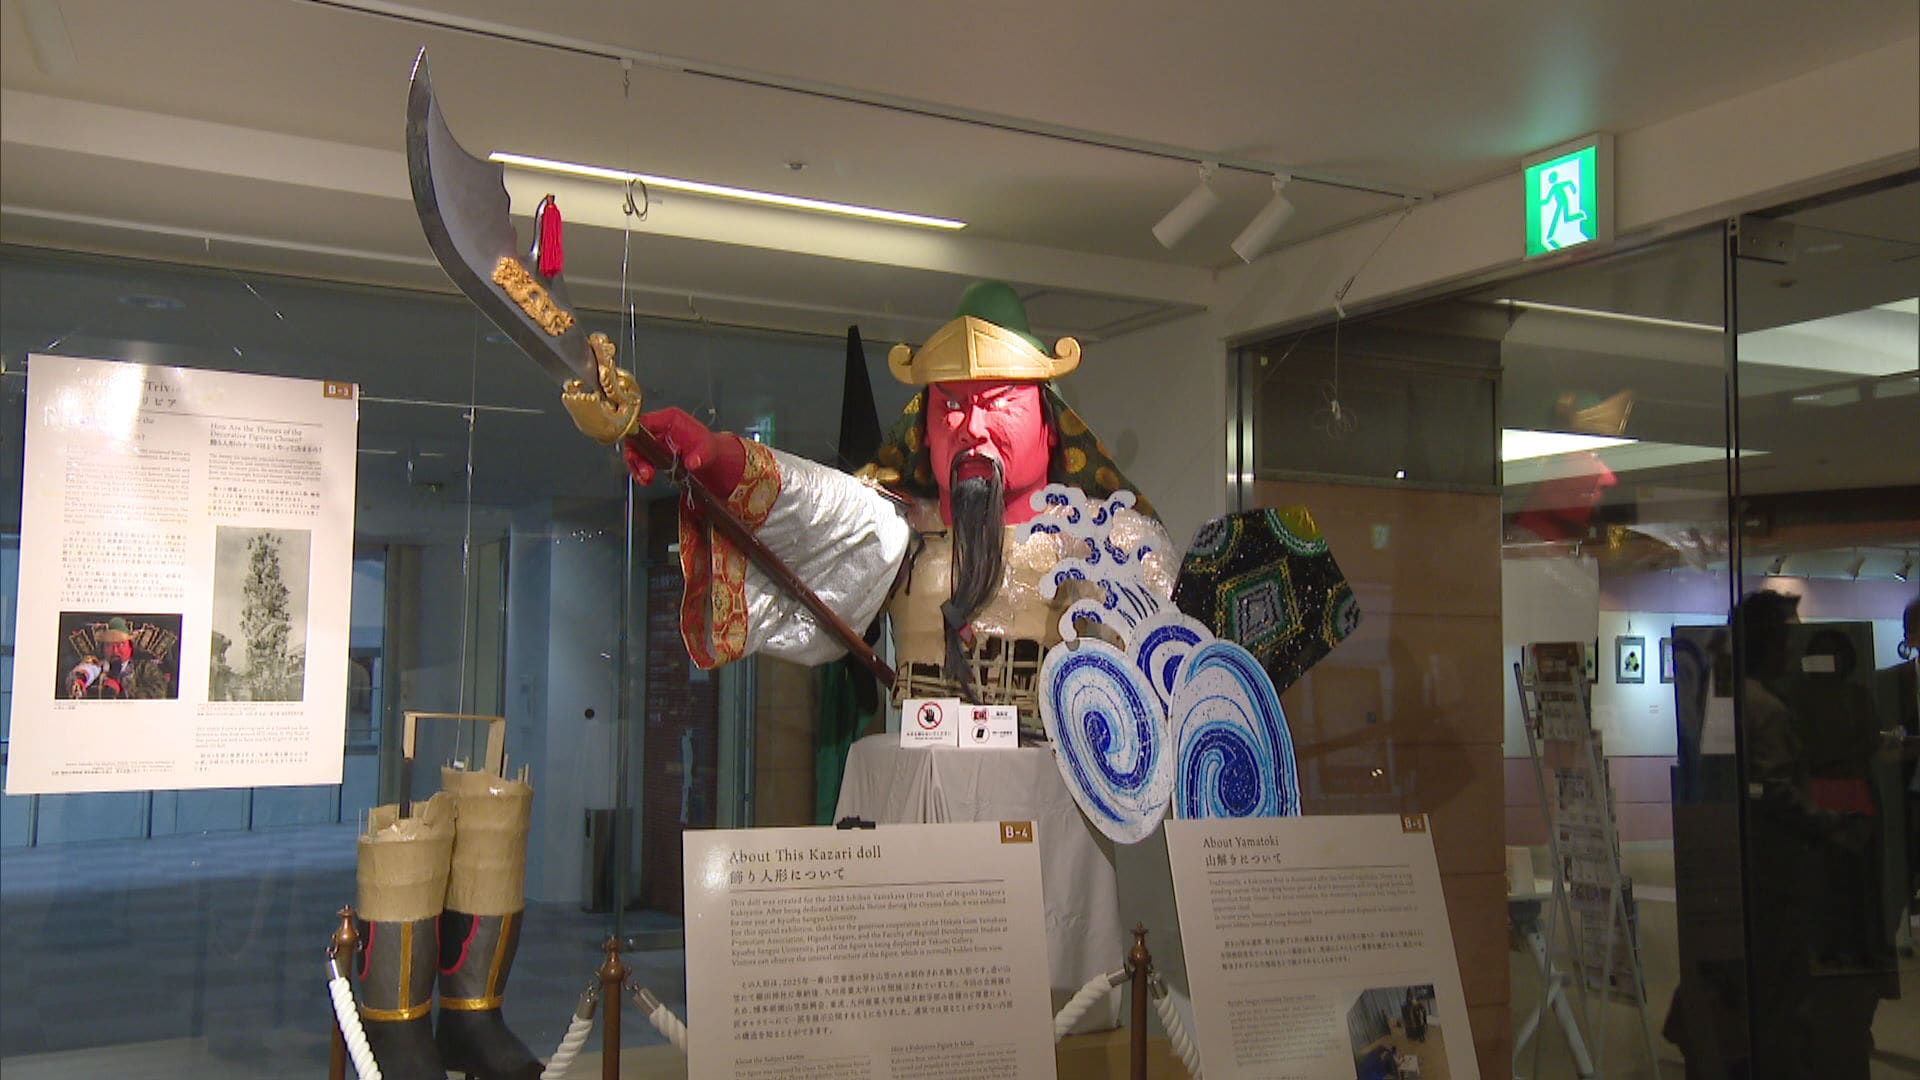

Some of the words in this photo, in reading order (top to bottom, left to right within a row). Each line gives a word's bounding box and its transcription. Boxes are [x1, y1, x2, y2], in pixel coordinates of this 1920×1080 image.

[243, 424, 253, 432] the
[1005, 825, 1028, 839] B-4
[1203, 836, 1233, 848] About
[1235, 834, 1280, 848] Yamatoki
[729, 849, 770, 864] About
[775, 848, 804, 862] This
[809, 847, 852, 861] Kazari
[856, 844, 881, 859] doll
[730, 867, 844, 884] 飾り人形について
[746, 898, 760, 906] doll
[814, 895, 825, 903] the
